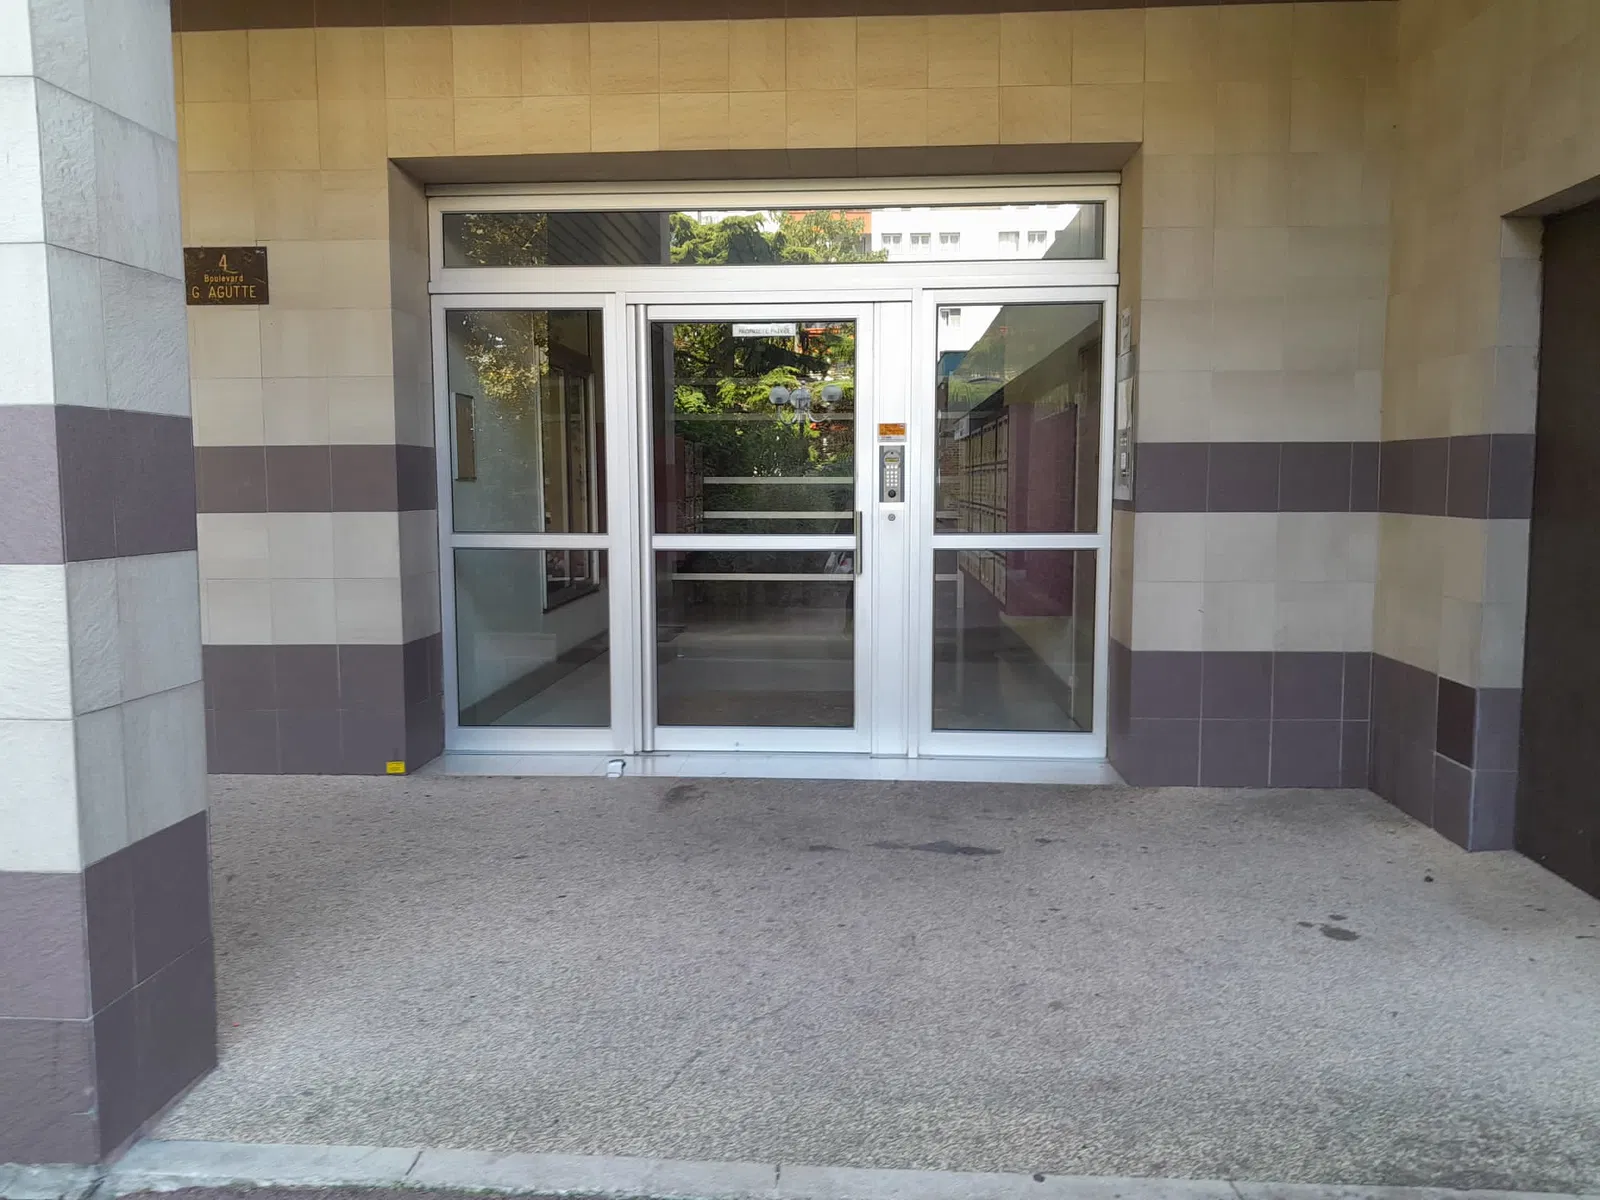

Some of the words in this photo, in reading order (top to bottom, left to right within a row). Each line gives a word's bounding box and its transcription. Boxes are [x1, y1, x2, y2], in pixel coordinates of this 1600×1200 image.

[218, 253, 228, 271] 4
[204, 273, 244, 283] Boulevard
[191, 286, 200, 299] G
[208, 285, 257, 299] AGUTTE
